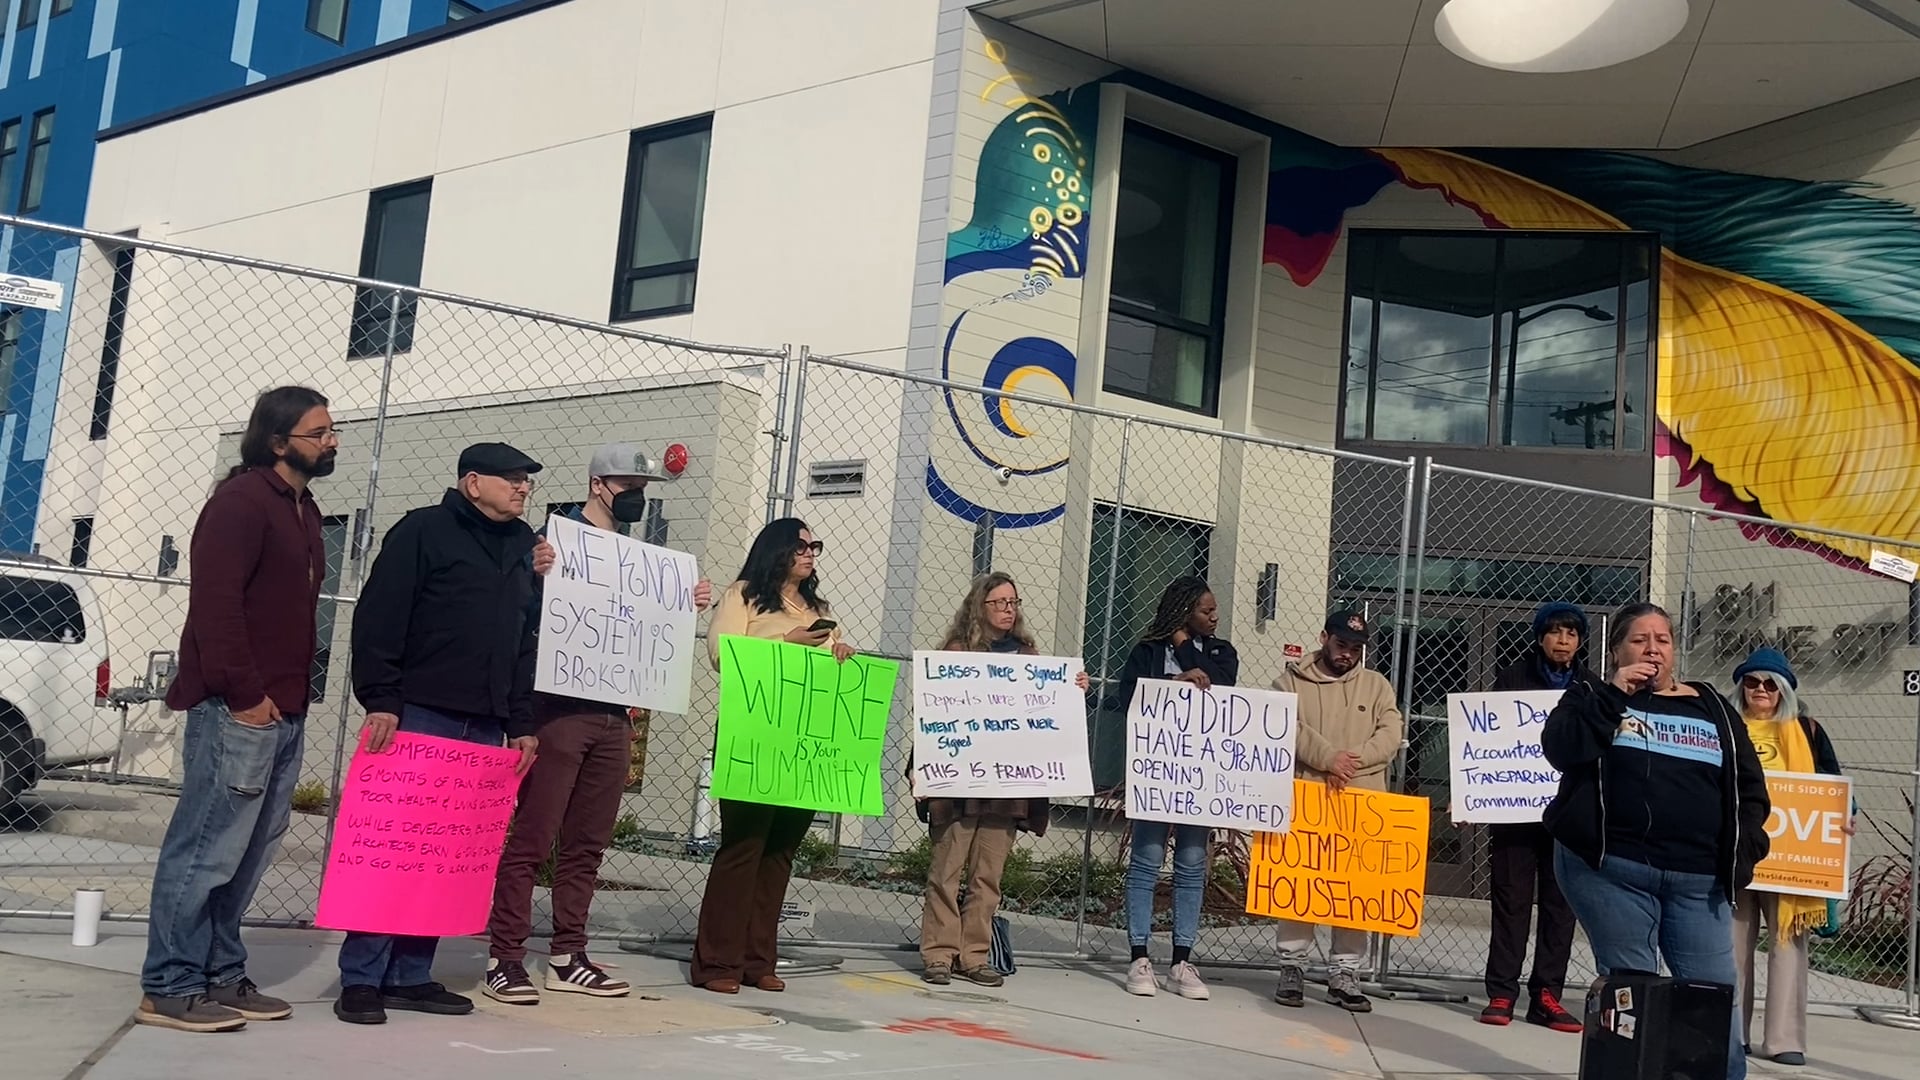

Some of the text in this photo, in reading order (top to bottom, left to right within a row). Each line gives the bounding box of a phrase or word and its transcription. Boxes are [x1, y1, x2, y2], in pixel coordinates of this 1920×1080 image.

[554, 519, 694, 613] WE KNOW
[607, 592, 635, 621] the
[549, 597, 643, 662] SYSTEM
[727, 638, 894, 743] WHERE
[1141, 683, 1193, 733] Why
[1263, 703, 1289, 740] U
[1460, 700, 1549, 733] We De
[919, 717, 960, 735] INTENT
[964, 718, 980, 732] TO
[984, 718, 1021, 731] RENTS
[1653, 721, 1677, 733] The
[1134, 721, 1194, 758] HAVE
[1200, 737, 1216, 763] A
[367, 742, 479, 768] OMPENSATE
[360, 764, 374, 782] 6
[376, 768, 427, 786] MONTHS
[433, 776, 450, 788] OF
[918, 761, 1067, 781] THIS IS FRAUD!!!
[360, 790, 393, 804] POOR
[398, 793, 440, 807] HEALTH
[1133, 784, 1202, 816] NEVER
[1772, 783, 1844, 797] THE SIDE OF
[348, 814, 394, 832] WHILE
[1769, 806, 1843, 845] OVE
[352, 833, 416, 853] ARCHITECTS
[420, 843, 448, 857] EARN
[338, 853, 365, 865] AND
[370, 857, 391, 870] GO
[1787, 853, 1841, 868] FAMILIES
